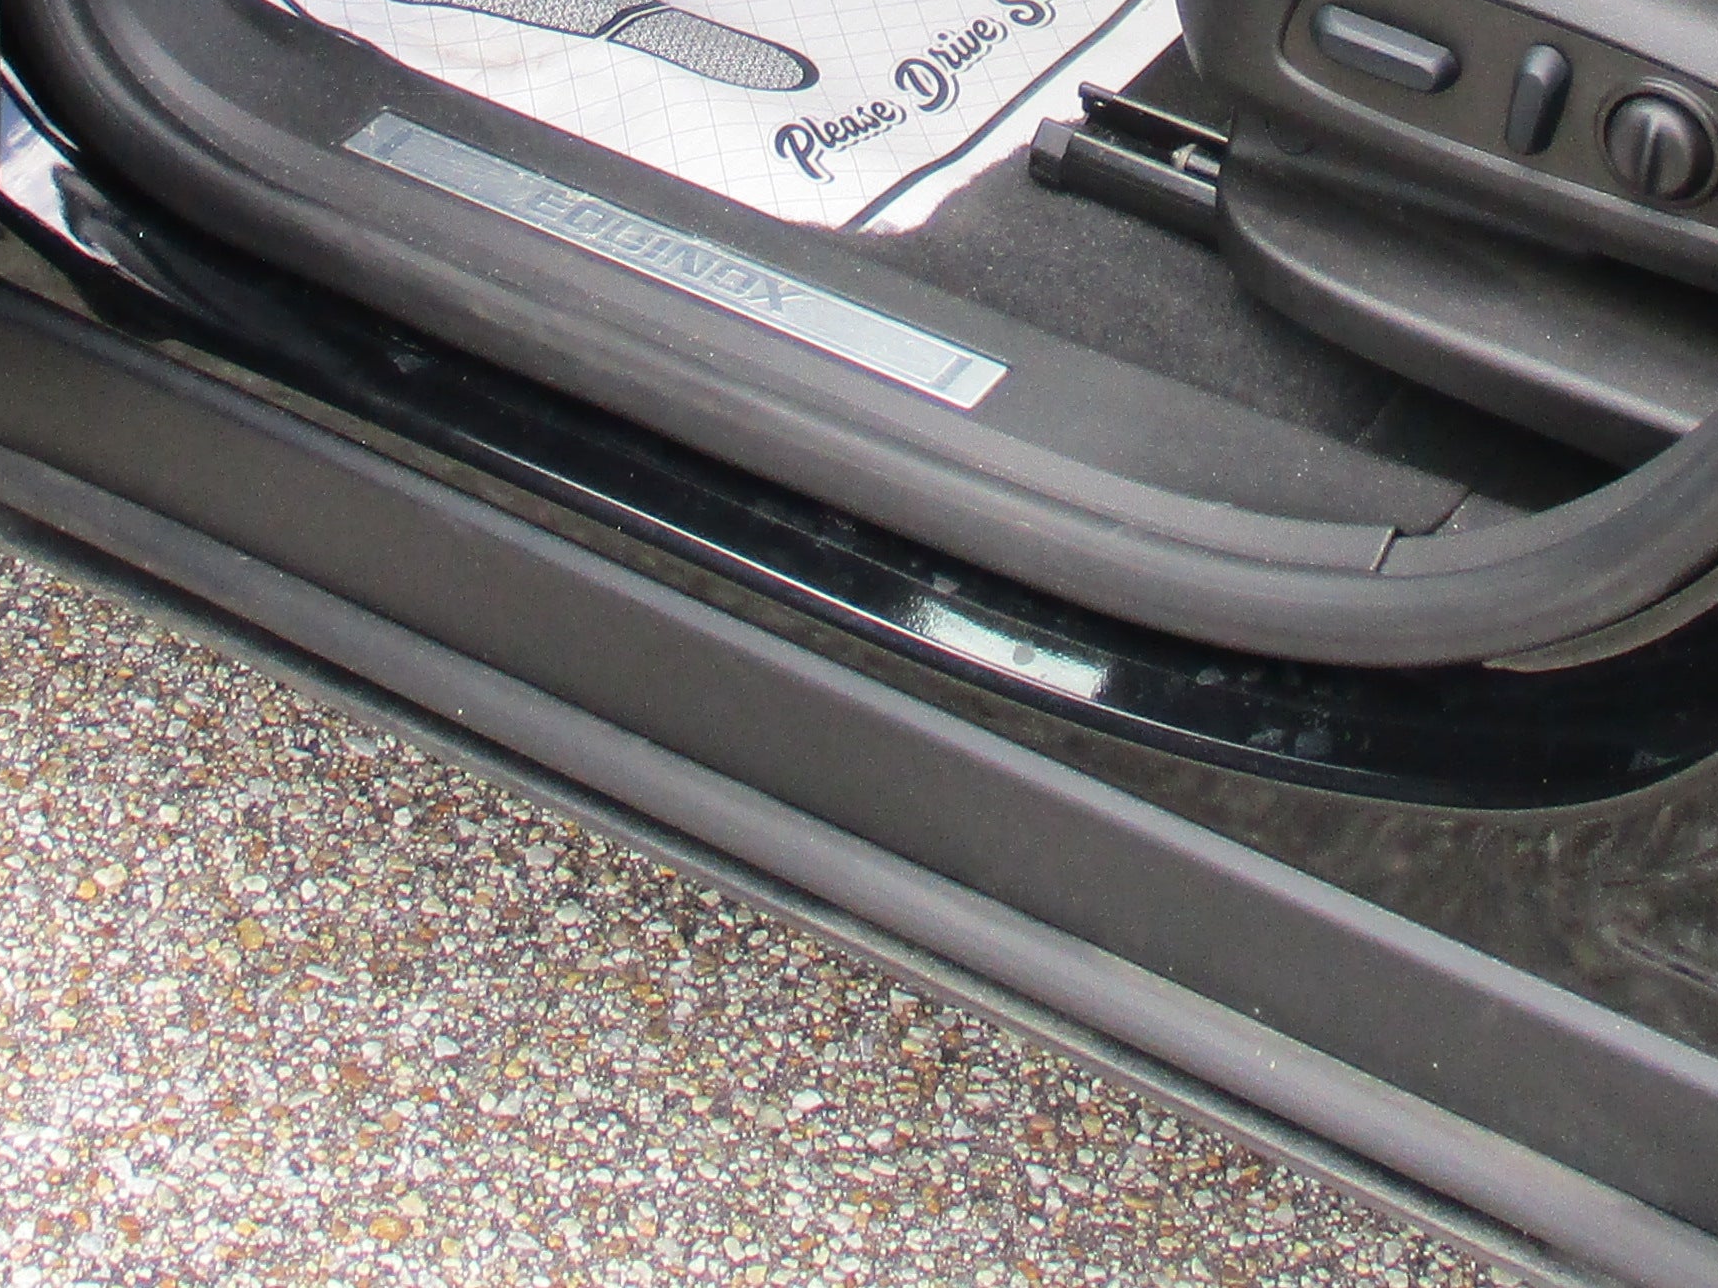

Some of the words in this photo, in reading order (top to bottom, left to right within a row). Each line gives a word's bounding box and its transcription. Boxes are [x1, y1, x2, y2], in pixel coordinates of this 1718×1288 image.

[773, 101, 906, 182] Please
[894, 18, 1007, 113] Drive
[528, 187, 809, 312] EQUINOX
